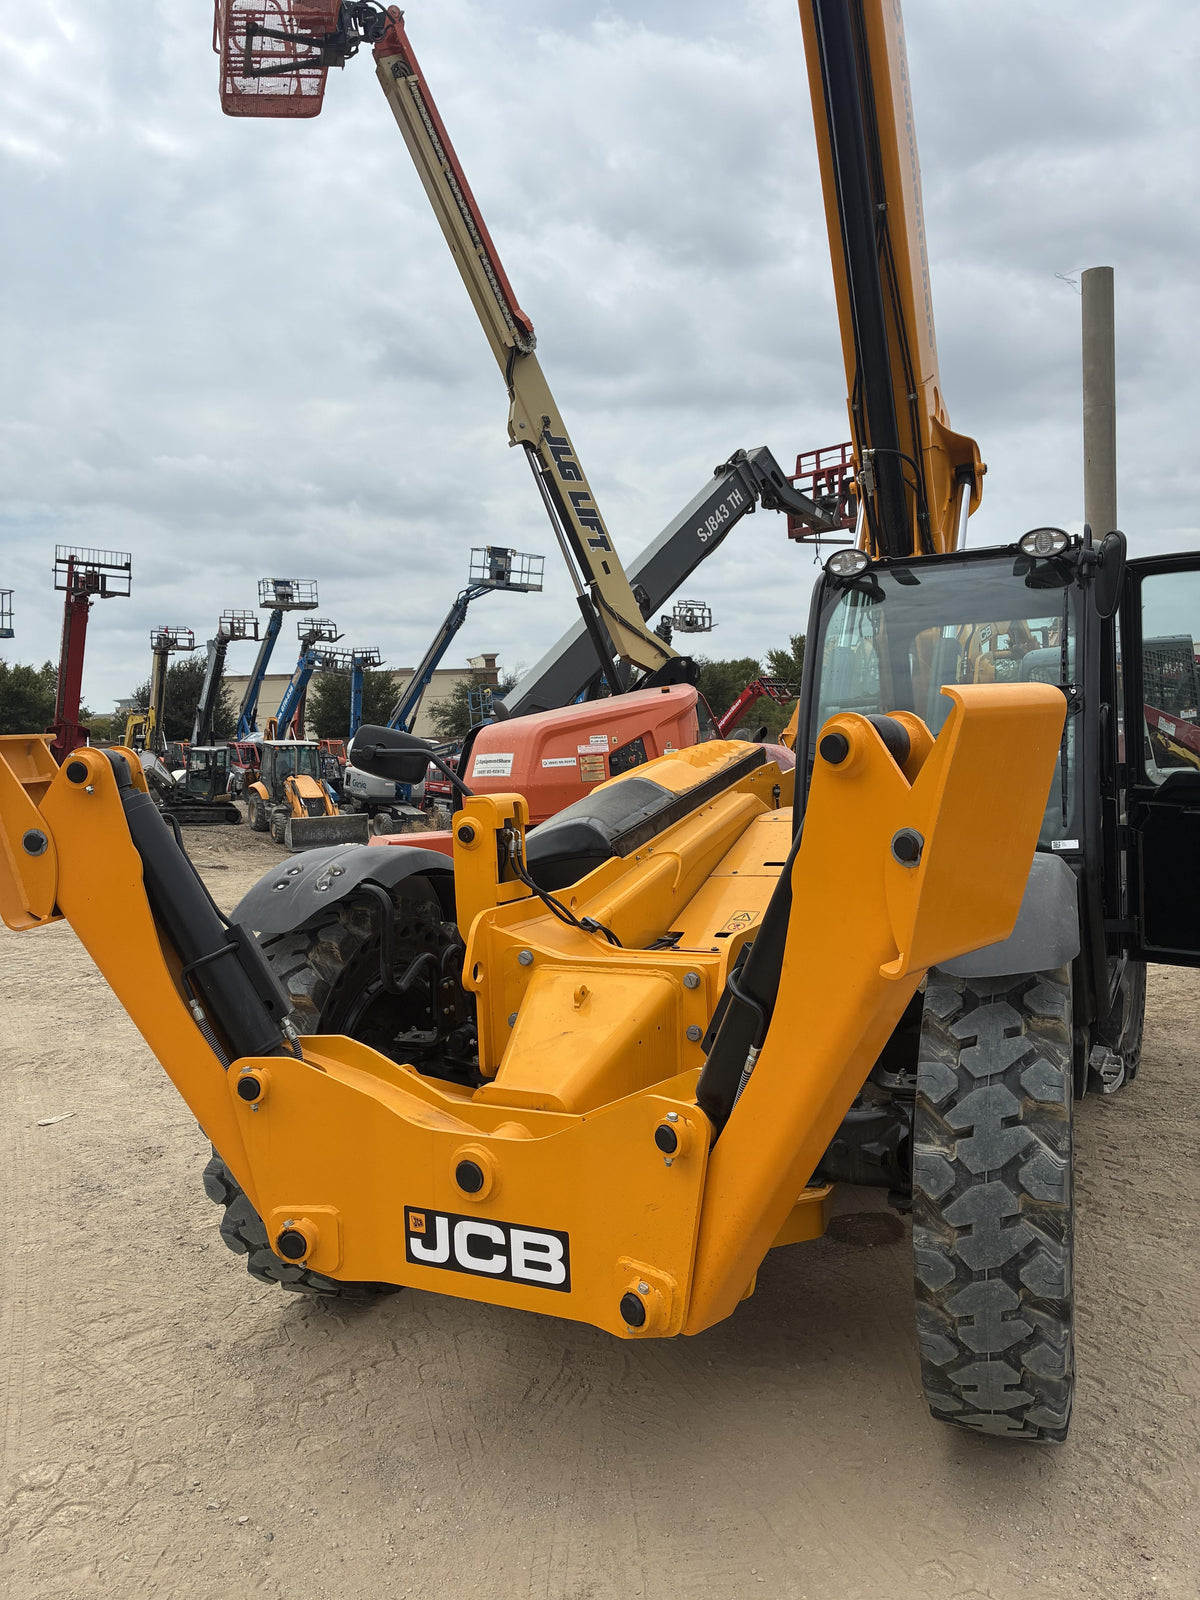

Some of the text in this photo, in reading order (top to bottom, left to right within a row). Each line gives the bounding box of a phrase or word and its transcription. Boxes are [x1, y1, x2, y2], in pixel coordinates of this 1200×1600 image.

[543, 429, 613, 552] JLG LIFT
[696, 488, 744, 542] SJ843 TH
[980, 625, 992, 640] CB
[352, 778, 367, 790] Genie
[409, 1215, 567, 1285] JCB
